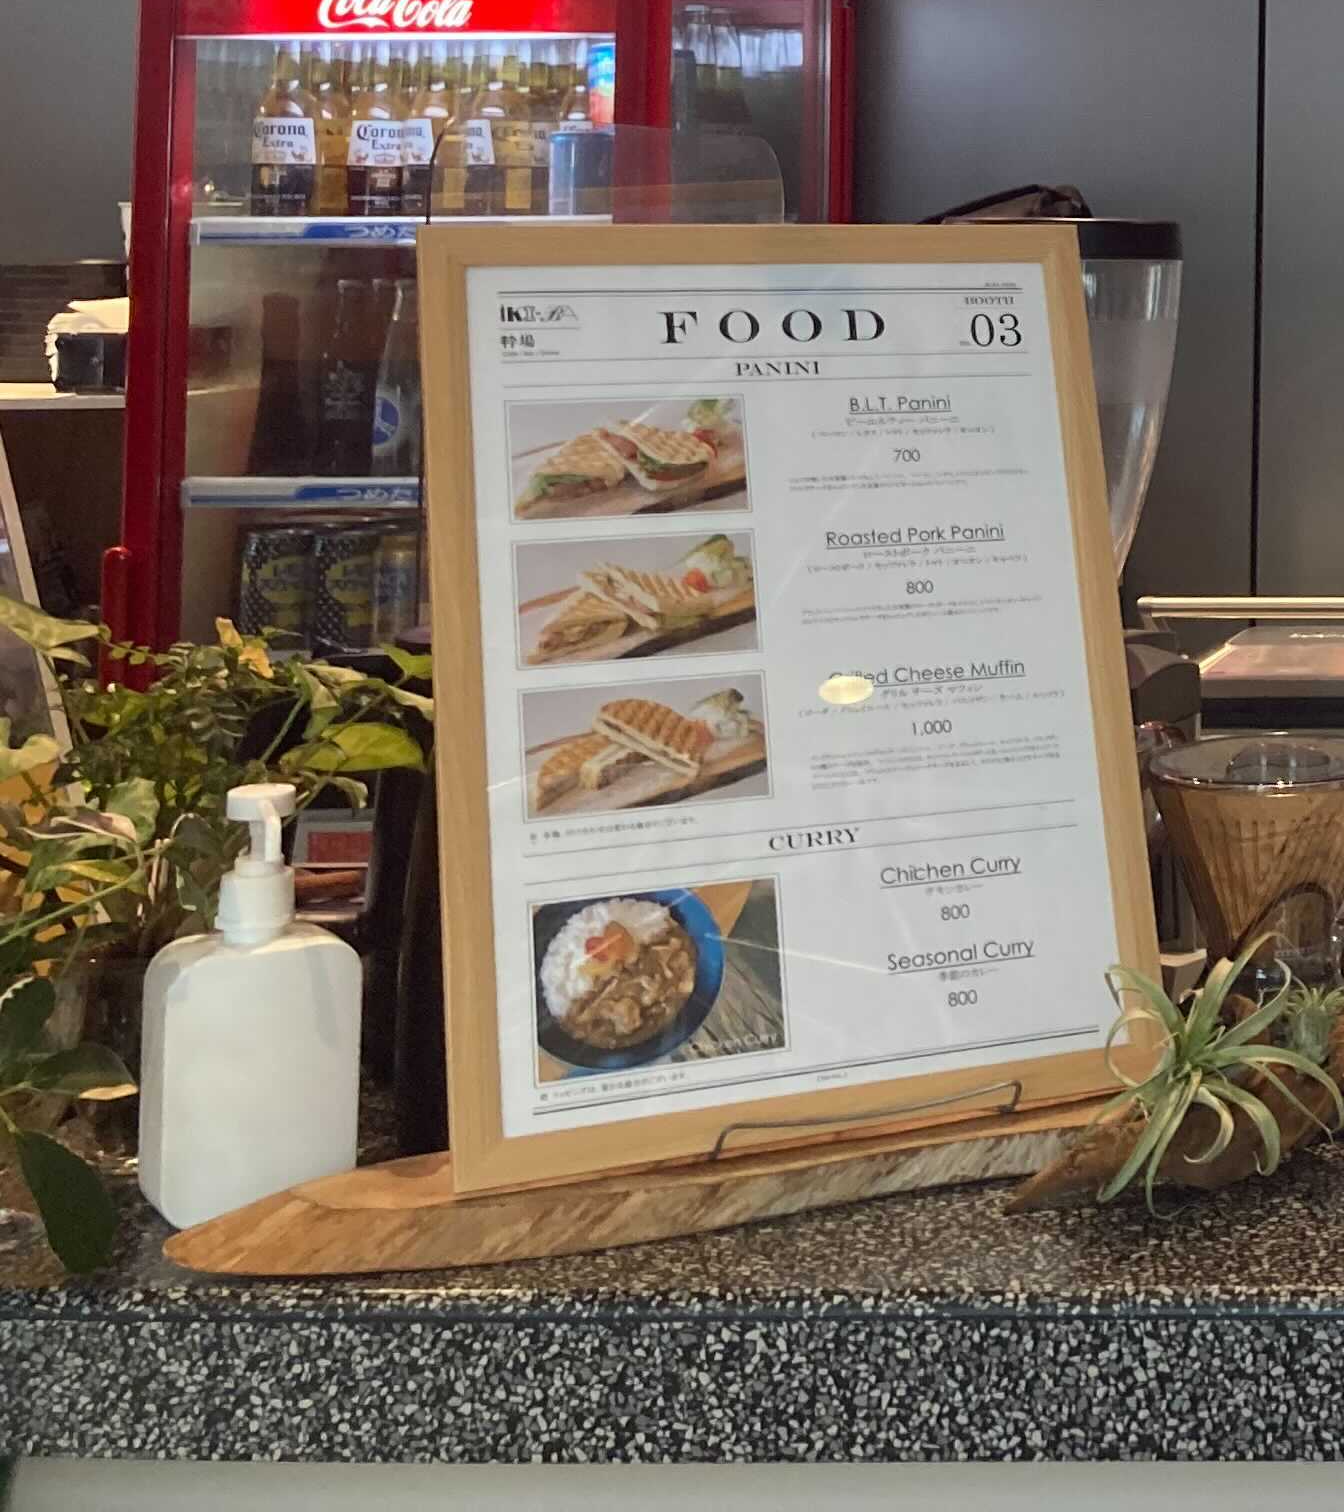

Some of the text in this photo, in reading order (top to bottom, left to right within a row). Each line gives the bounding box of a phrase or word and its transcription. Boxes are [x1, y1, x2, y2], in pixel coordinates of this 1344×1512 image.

[657, 309, 886, 345] FOOD
[971, 314, 1021, 347] 03
[735, 361, 820, 377] PANINI
[898, 396, 951, 410] Panini
[894, 449, 920, 462] 700
[826, 524, 1004, 545] Roasted Pork Panini
[906, 581, 934, 594] 800
[895, 665, 964, 683] Cheese
[971, 660, 1025, 676] Muffin
[912, 720, 952, 736] 1,000
[769, 828, 860, 851] CURRY
[970, 857, 1021, 874] Curry
[940, 904, 970, 921] 800
[887, 941, 1034, 970] Seasonal Curry
[948, 989, 978, 1007] 800
